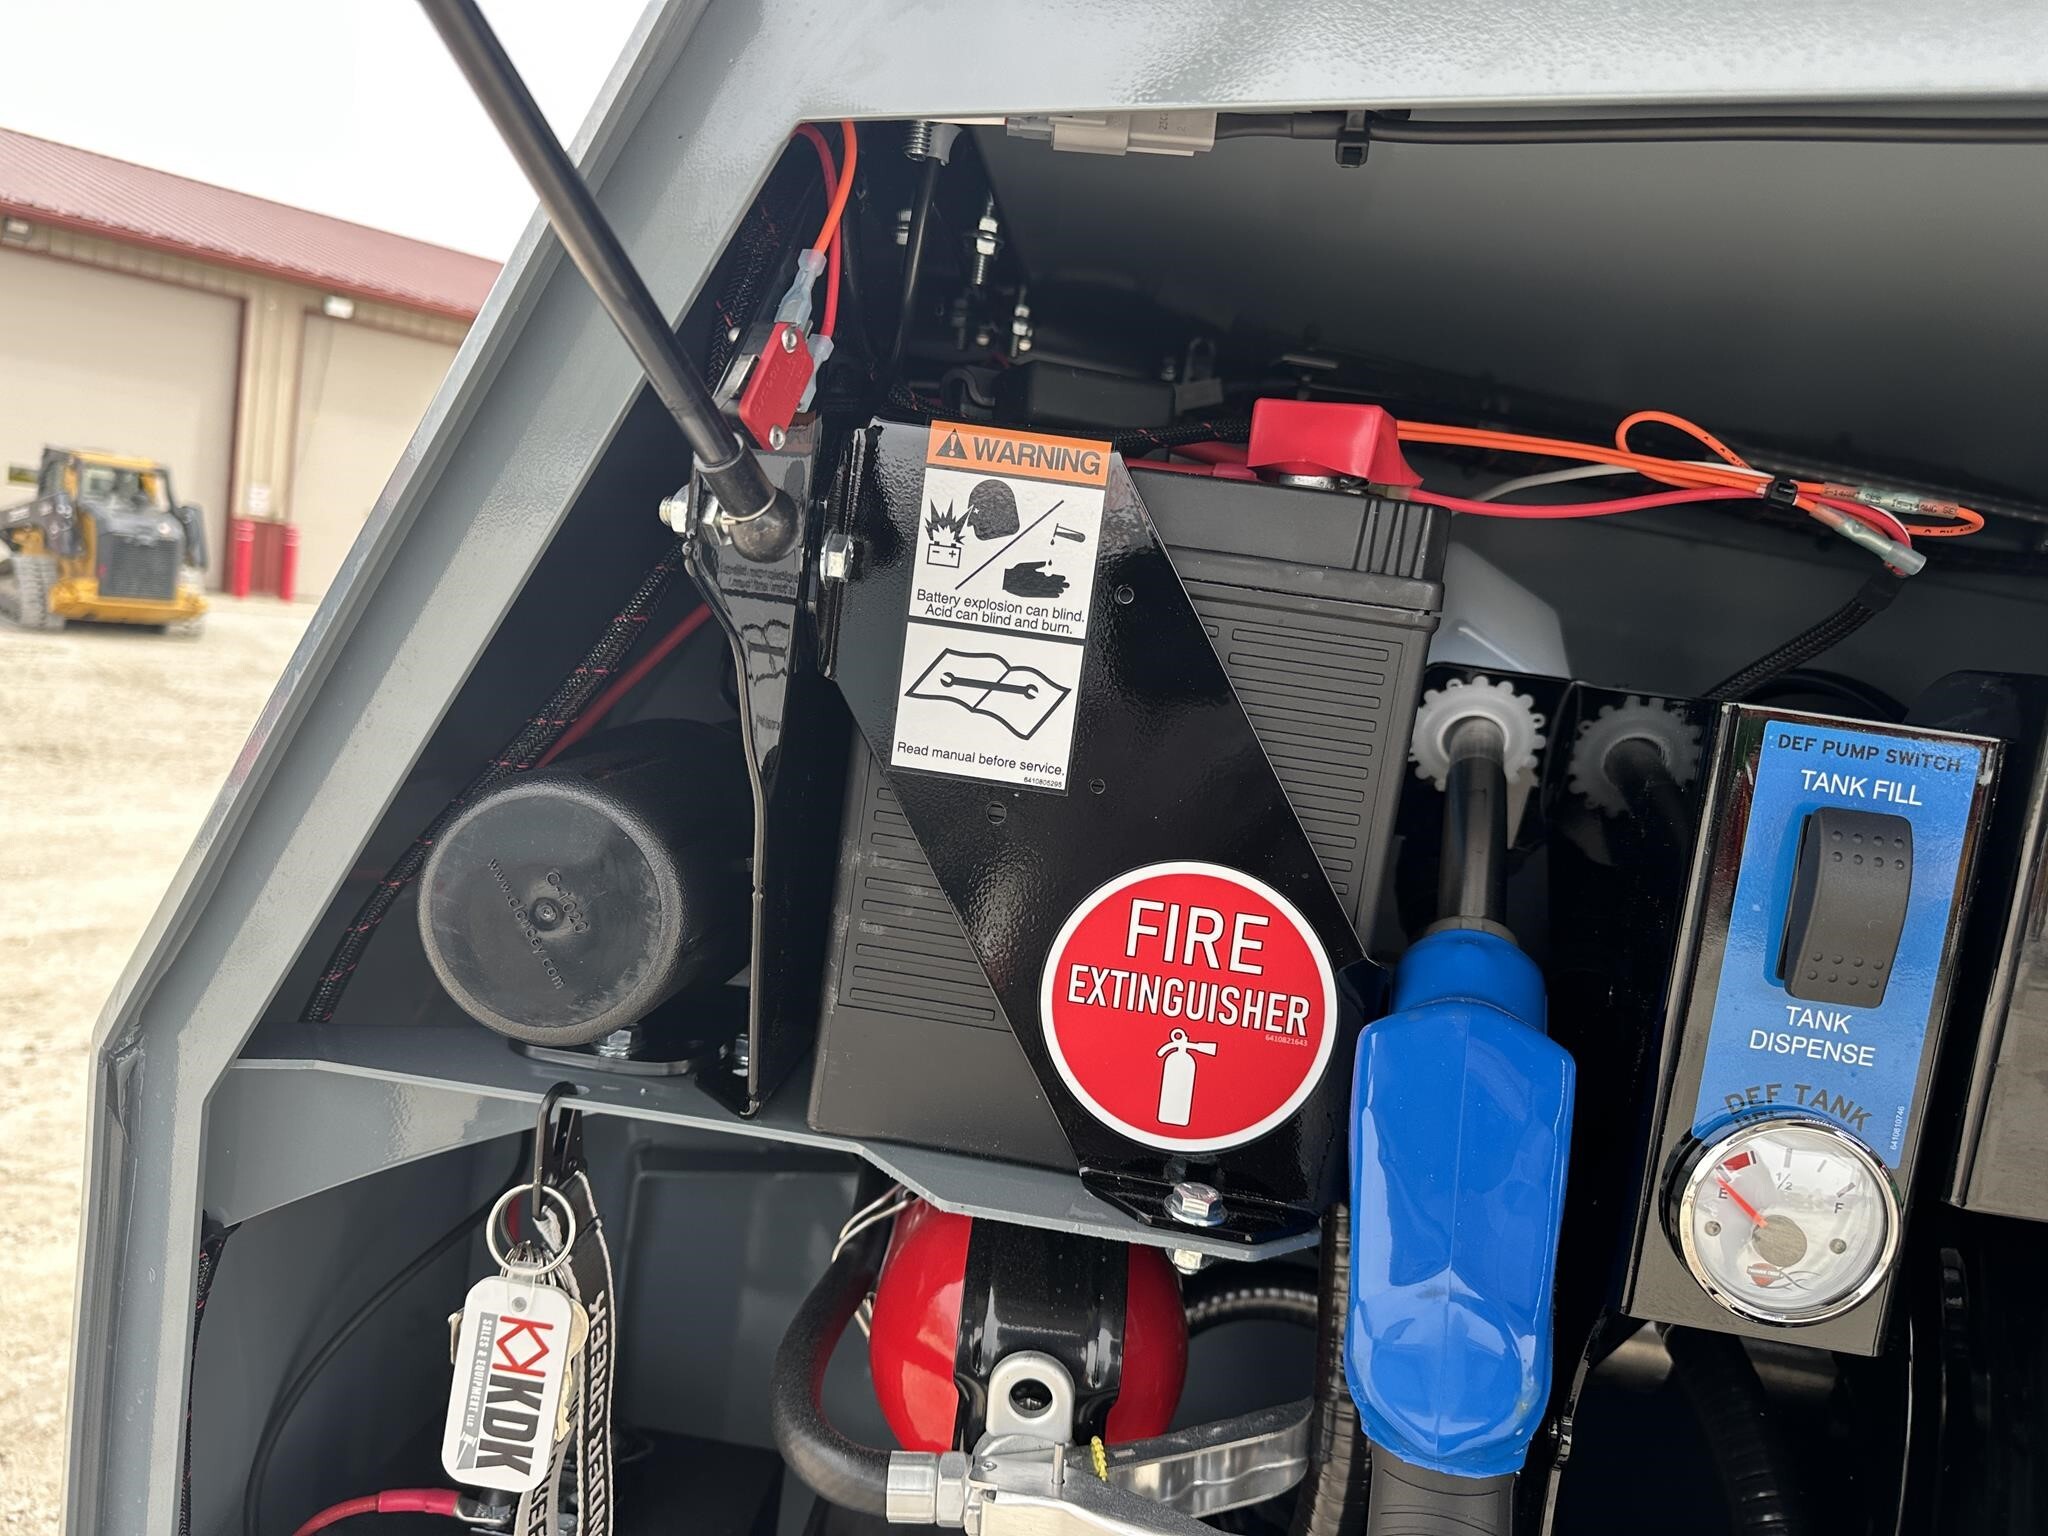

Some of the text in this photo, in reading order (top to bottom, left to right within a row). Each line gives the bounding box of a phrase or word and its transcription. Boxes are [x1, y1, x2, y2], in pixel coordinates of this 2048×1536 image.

[973, 436, 1101, 476] WARNING
[917, 588, 1085, 623] Battery explosion can blind.
[925, 603, 1073, 634] Acid can blind and burn.
[897, 741, 1065, 776] Read manual before service.
[1778, 734, 1961, 773] DEF PUMP SWITCH
[1801, 769, 1922, 806] TANK FILL
[1124, 897, 1270, 976] FIRE
[1068, 963, 1310, 1037] EXTINGUISHER
[1786, 1005, 1852, 1034] TANK
[1749, 1029, 1876, 1067] DISPENSE
[1724, 1083, 1872, 1132] DEF TANK
[1718, 1187, 1728, 1200] E
[1834, 1202, 1844, 1214] F
[479, 1319, 493, 1348] SALES
[587, 1290, 608, 1431] CREEK
[468, 1360, 487, 1413] EQUIPMENT
[476, 1373, 545, 1477] KDK
